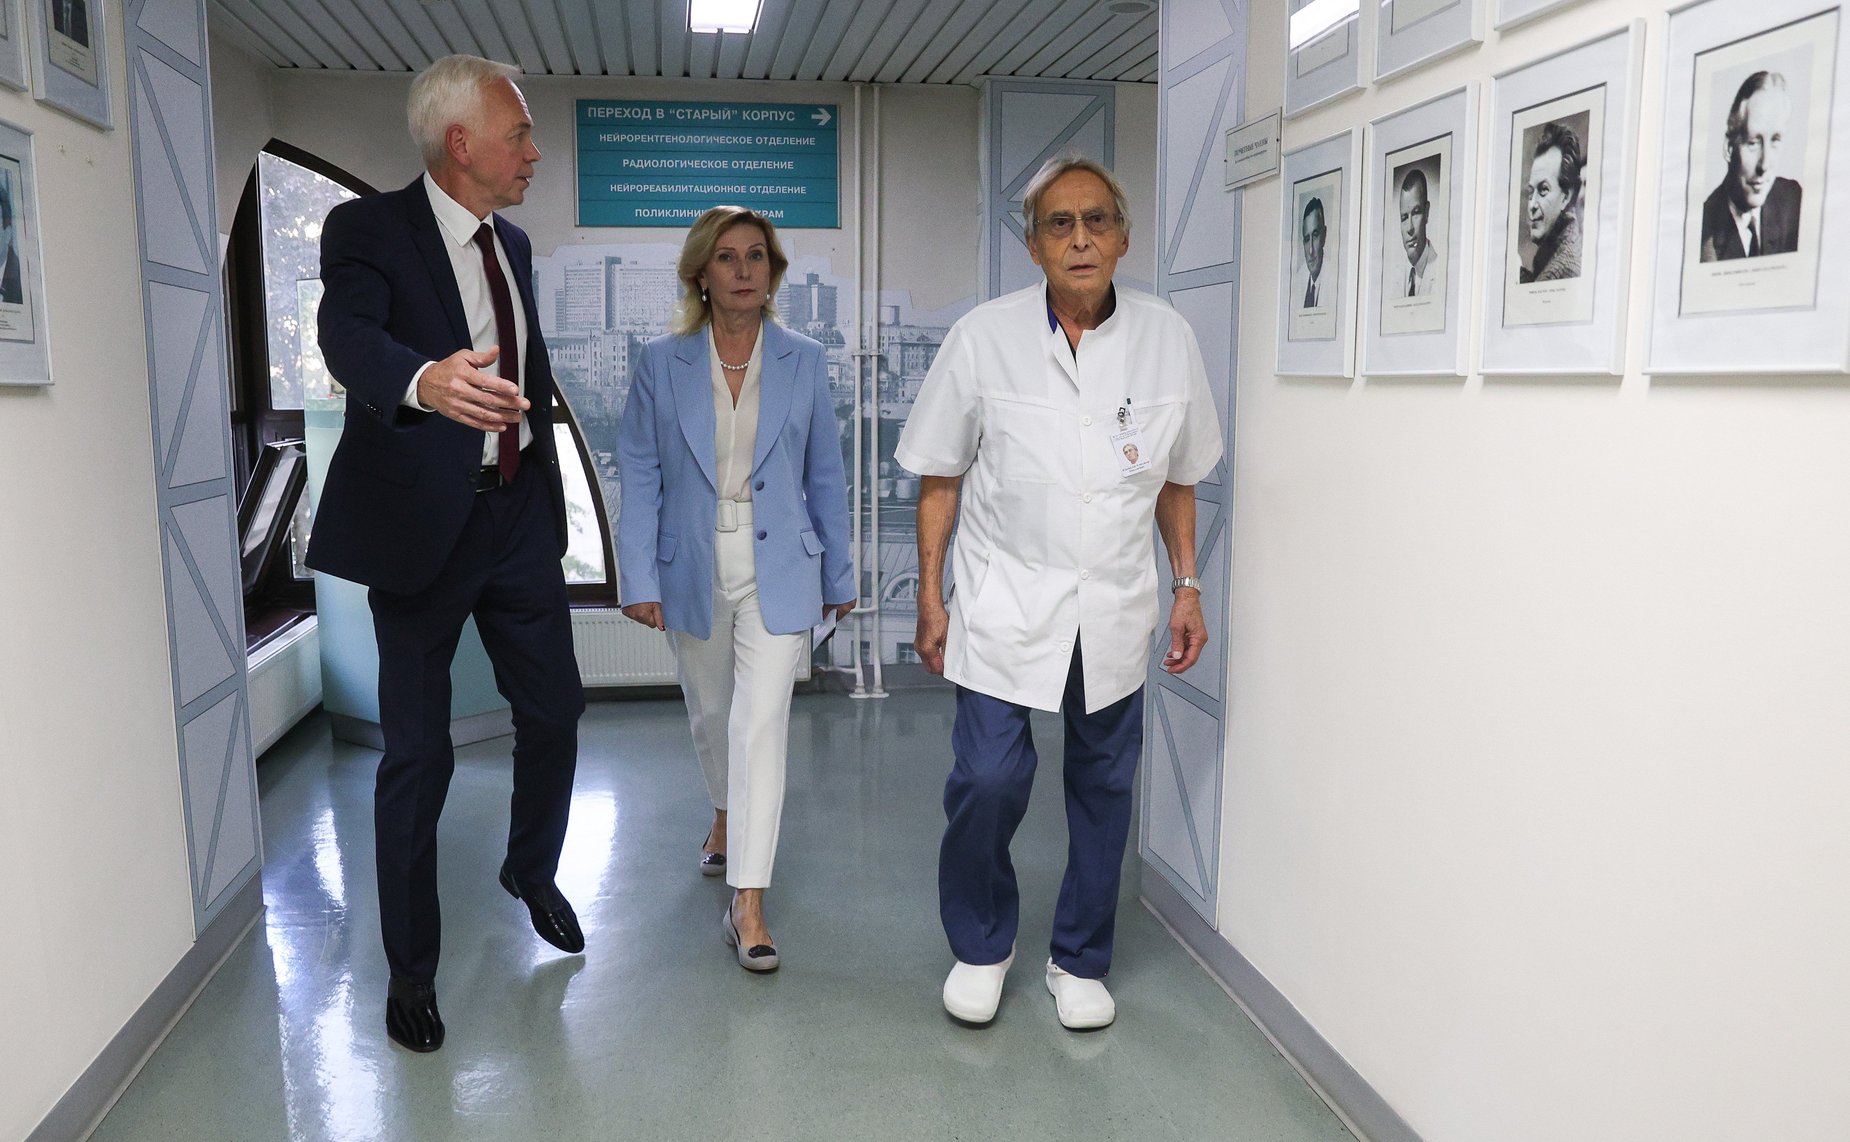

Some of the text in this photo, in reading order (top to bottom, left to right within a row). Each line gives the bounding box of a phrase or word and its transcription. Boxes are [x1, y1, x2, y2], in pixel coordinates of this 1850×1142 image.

[588, 107, 652, 120] ПЕРЕХОД
[656, 108, 665, 119] В
[743, 110, 796, 121] КОРПУС
[599, 132, 816, 146] НЕЙРОРЕНТГЕНОЛОГИЧЕСКОЕ ОТДЕЛЕНИЕ
[622, 159, 794, 170] РАДИОЛОГИЧЕСКОЕ ОТДЕЛЕНИЕ
[610, 183, 807, 195] НЕЙРОРЕАБИЛИТАЦИОННОЕ ОТДЕЛЕНИЕ
